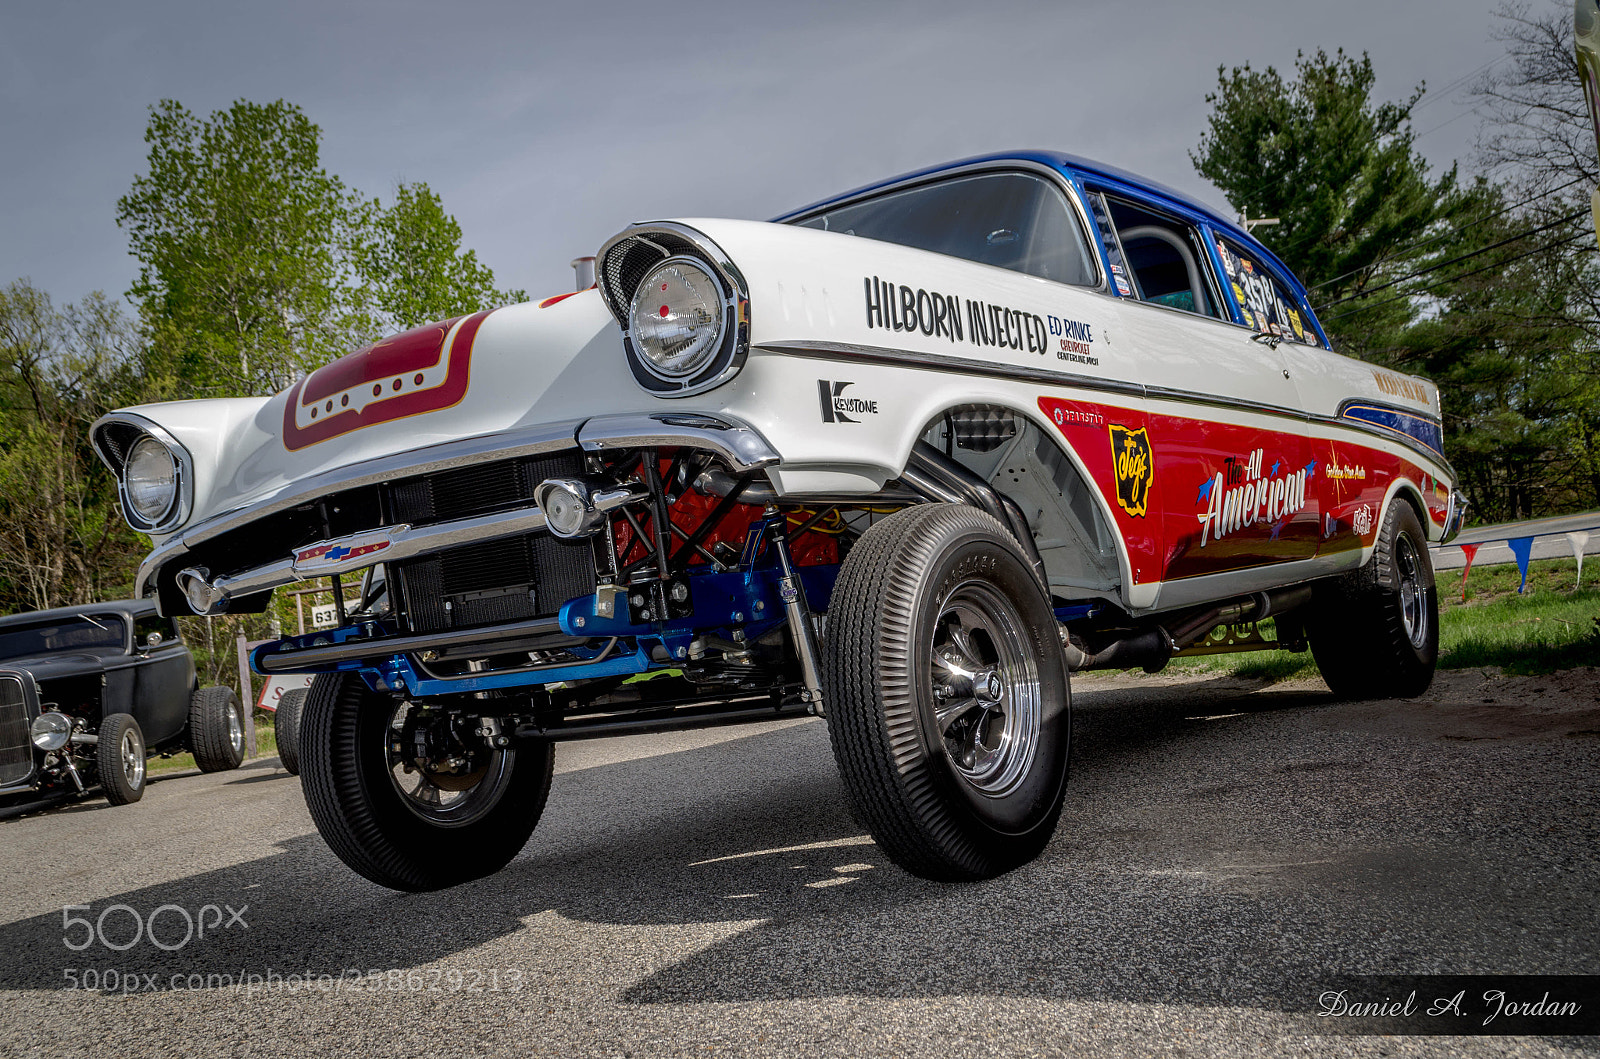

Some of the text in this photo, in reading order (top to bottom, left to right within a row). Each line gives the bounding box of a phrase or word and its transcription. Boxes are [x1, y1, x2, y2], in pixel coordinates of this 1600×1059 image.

[864, 275, 1048, 355] HILBORN INJECTED
[1047, 315, 1094, 343] ED RINKE
[1060, 338, 1091, 355] CHEVROLET
[834, 397, 879, 415] KEYSTONE
[1063, 409, 1104, 425] GEARSTAR
[1224, 448, 1264, 486] The All
[1197, 468, 1306, 548] American
